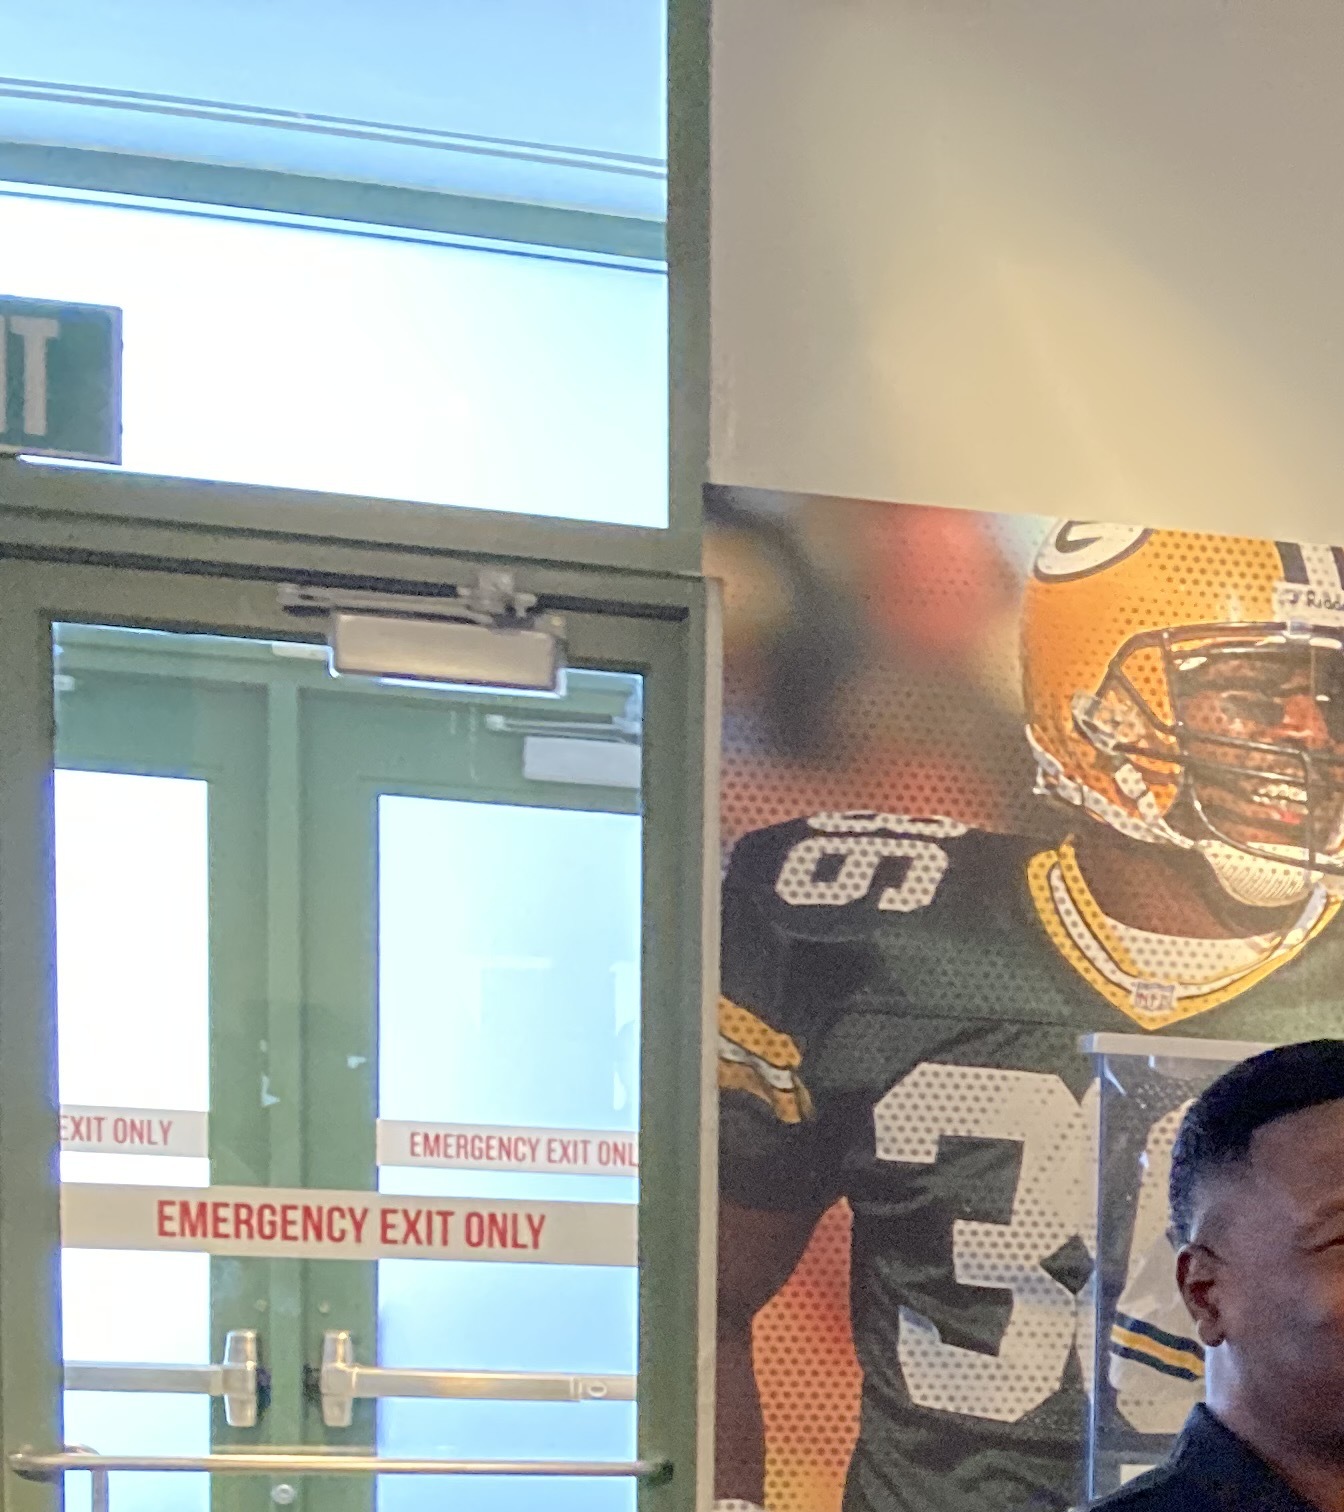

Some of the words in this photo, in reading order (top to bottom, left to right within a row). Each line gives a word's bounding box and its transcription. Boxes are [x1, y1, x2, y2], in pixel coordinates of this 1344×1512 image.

[113, 1117, 173, 1146] ONLY
[410, 1131, 540, 1163] EMERGENCY
[546, 1138, 592, 1165] EXIT
[598, 1140, 639, 1167] ONL
[158, 1199, 368, 1243] EMERGENCY
[380, 1208, 454, 1245] EXIT
[464, 1211, 545, 1249] ONLY
